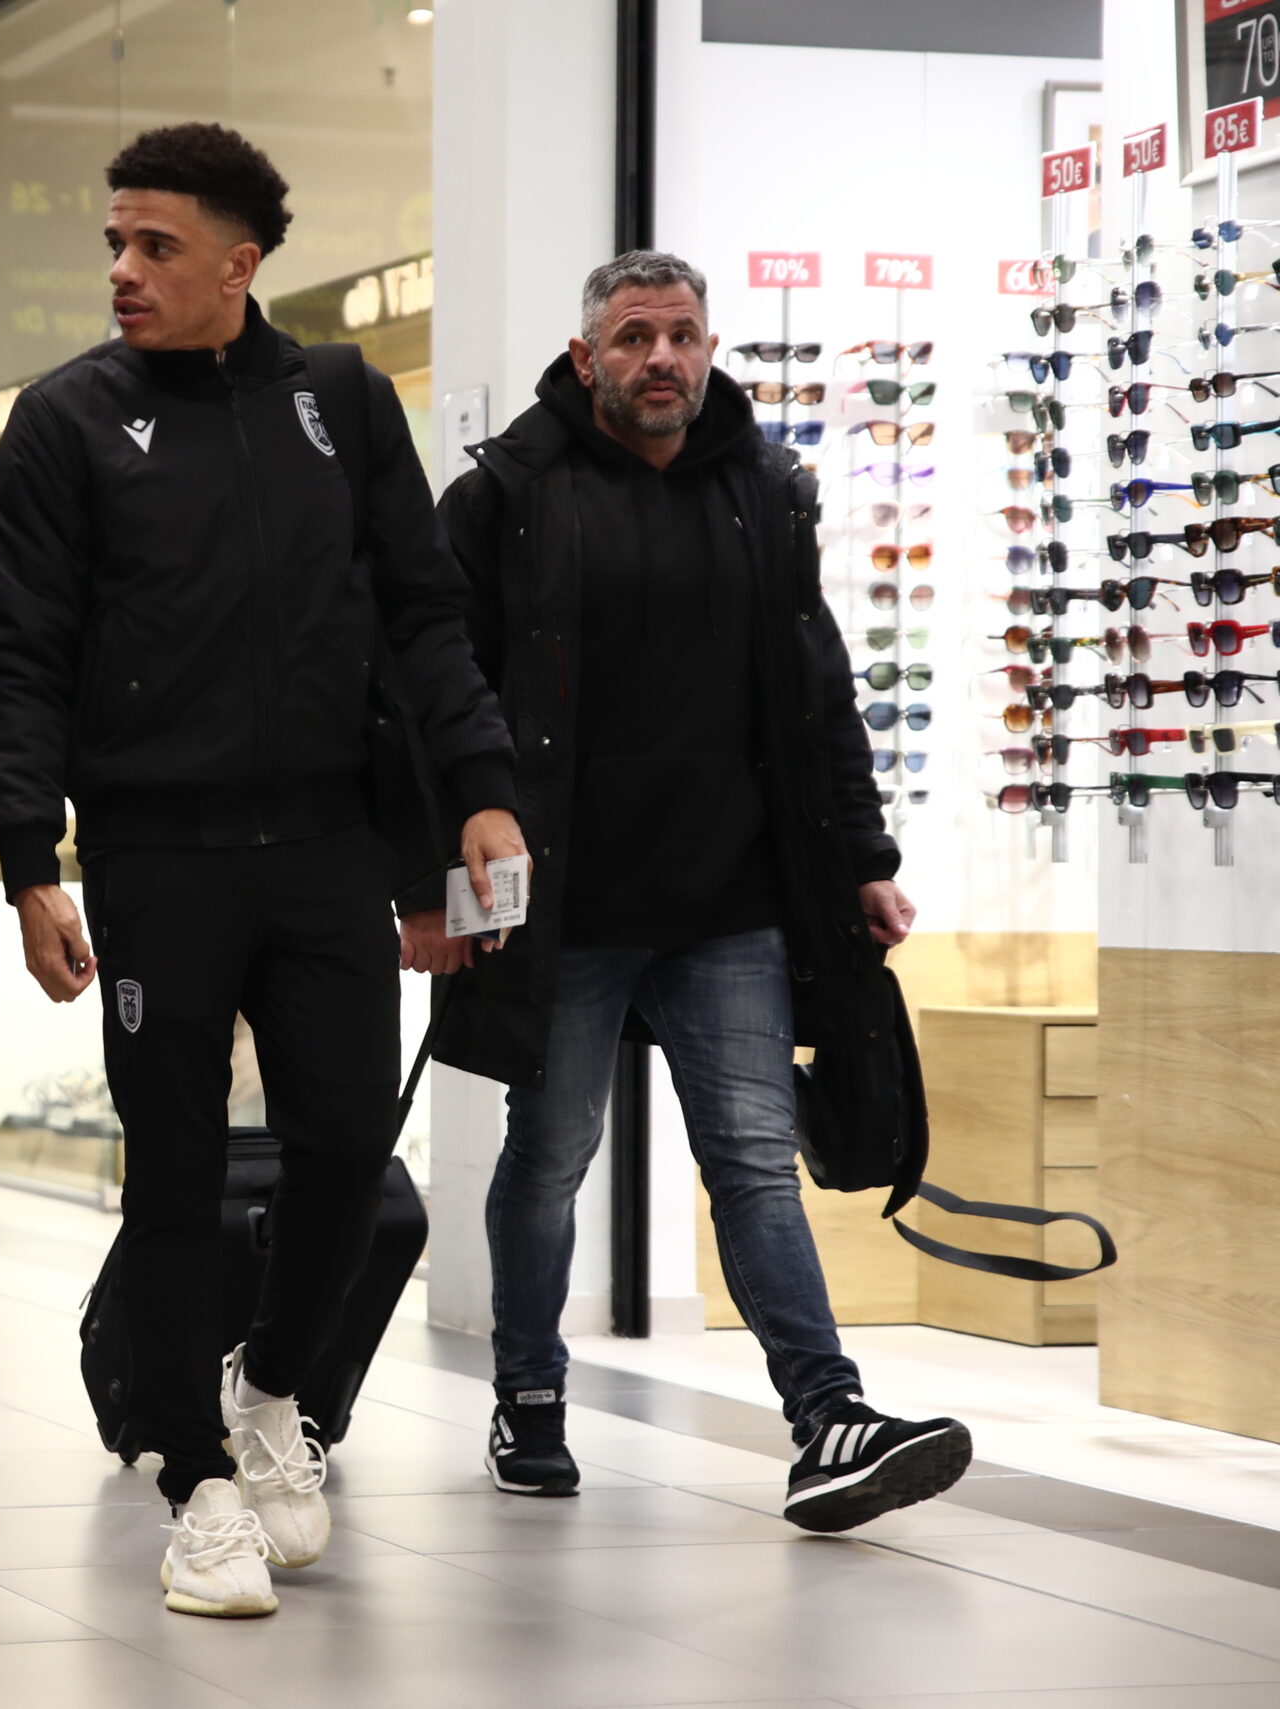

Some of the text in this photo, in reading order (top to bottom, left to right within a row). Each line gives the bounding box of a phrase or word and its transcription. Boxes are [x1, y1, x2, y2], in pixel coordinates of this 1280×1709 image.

[1214, 113, 1249, 150] 85€
[1131, 136, 1160, 170] 50€
[1051, 156, 1083, 190] 50€
[760, 257, 810, 282] 70%
[875, 257, 923, 284] 70%
